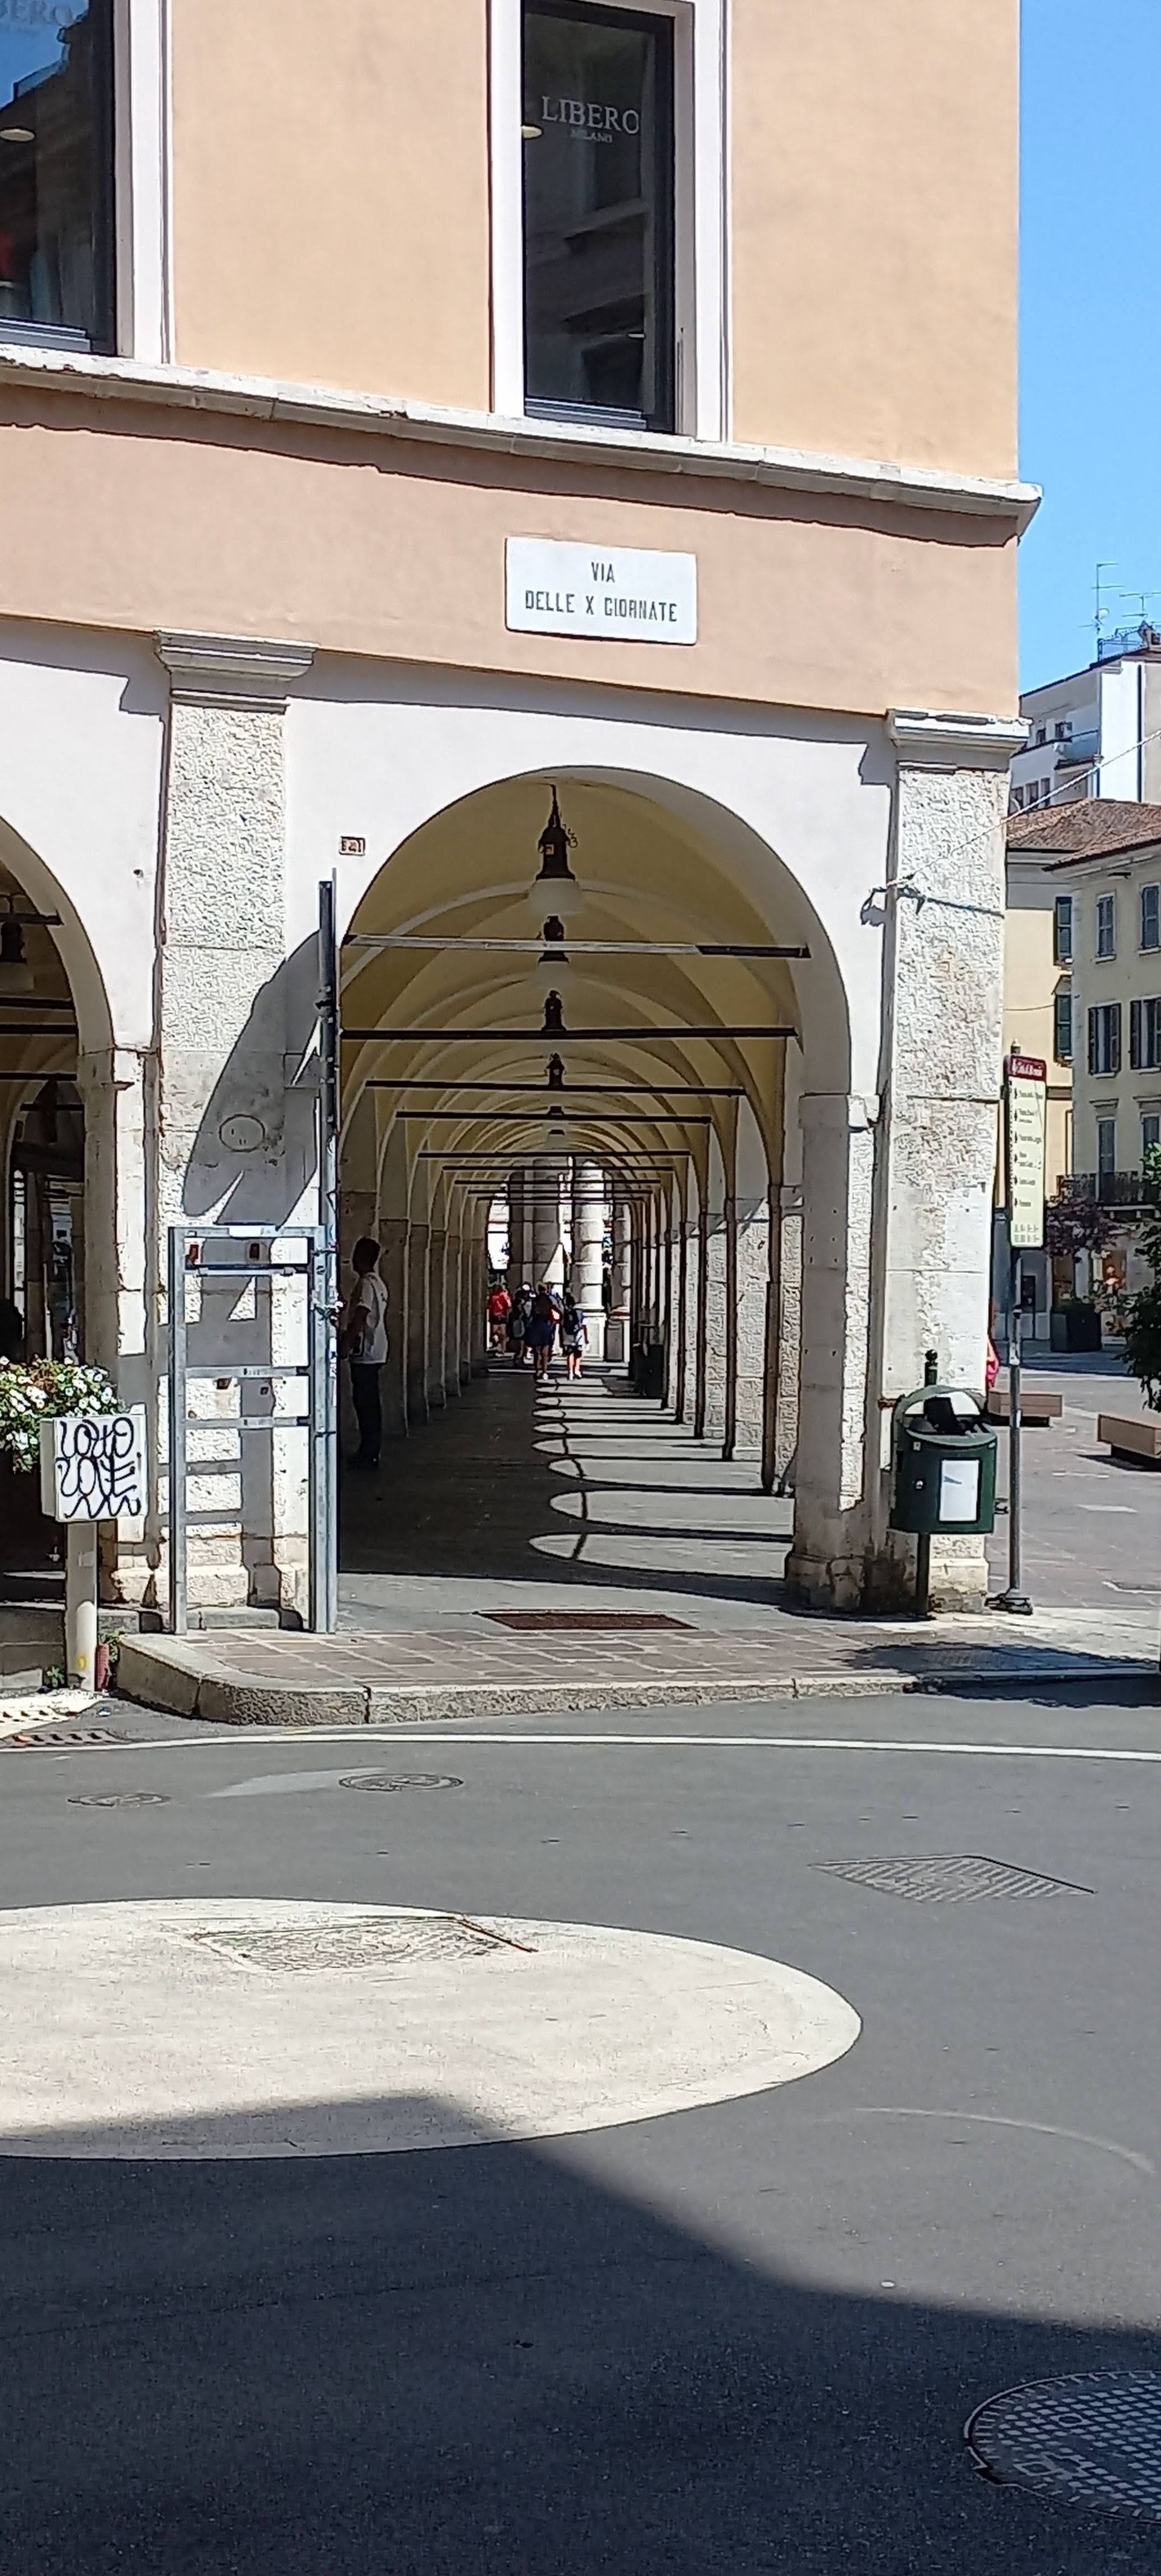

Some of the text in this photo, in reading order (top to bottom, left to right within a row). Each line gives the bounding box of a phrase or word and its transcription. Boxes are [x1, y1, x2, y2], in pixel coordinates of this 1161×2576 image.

[542, 96, 640, 134] LIBERO
[591, 561, 616, 583] VIA
[525, 590, 678, 622] DELLE X GIORNATE
